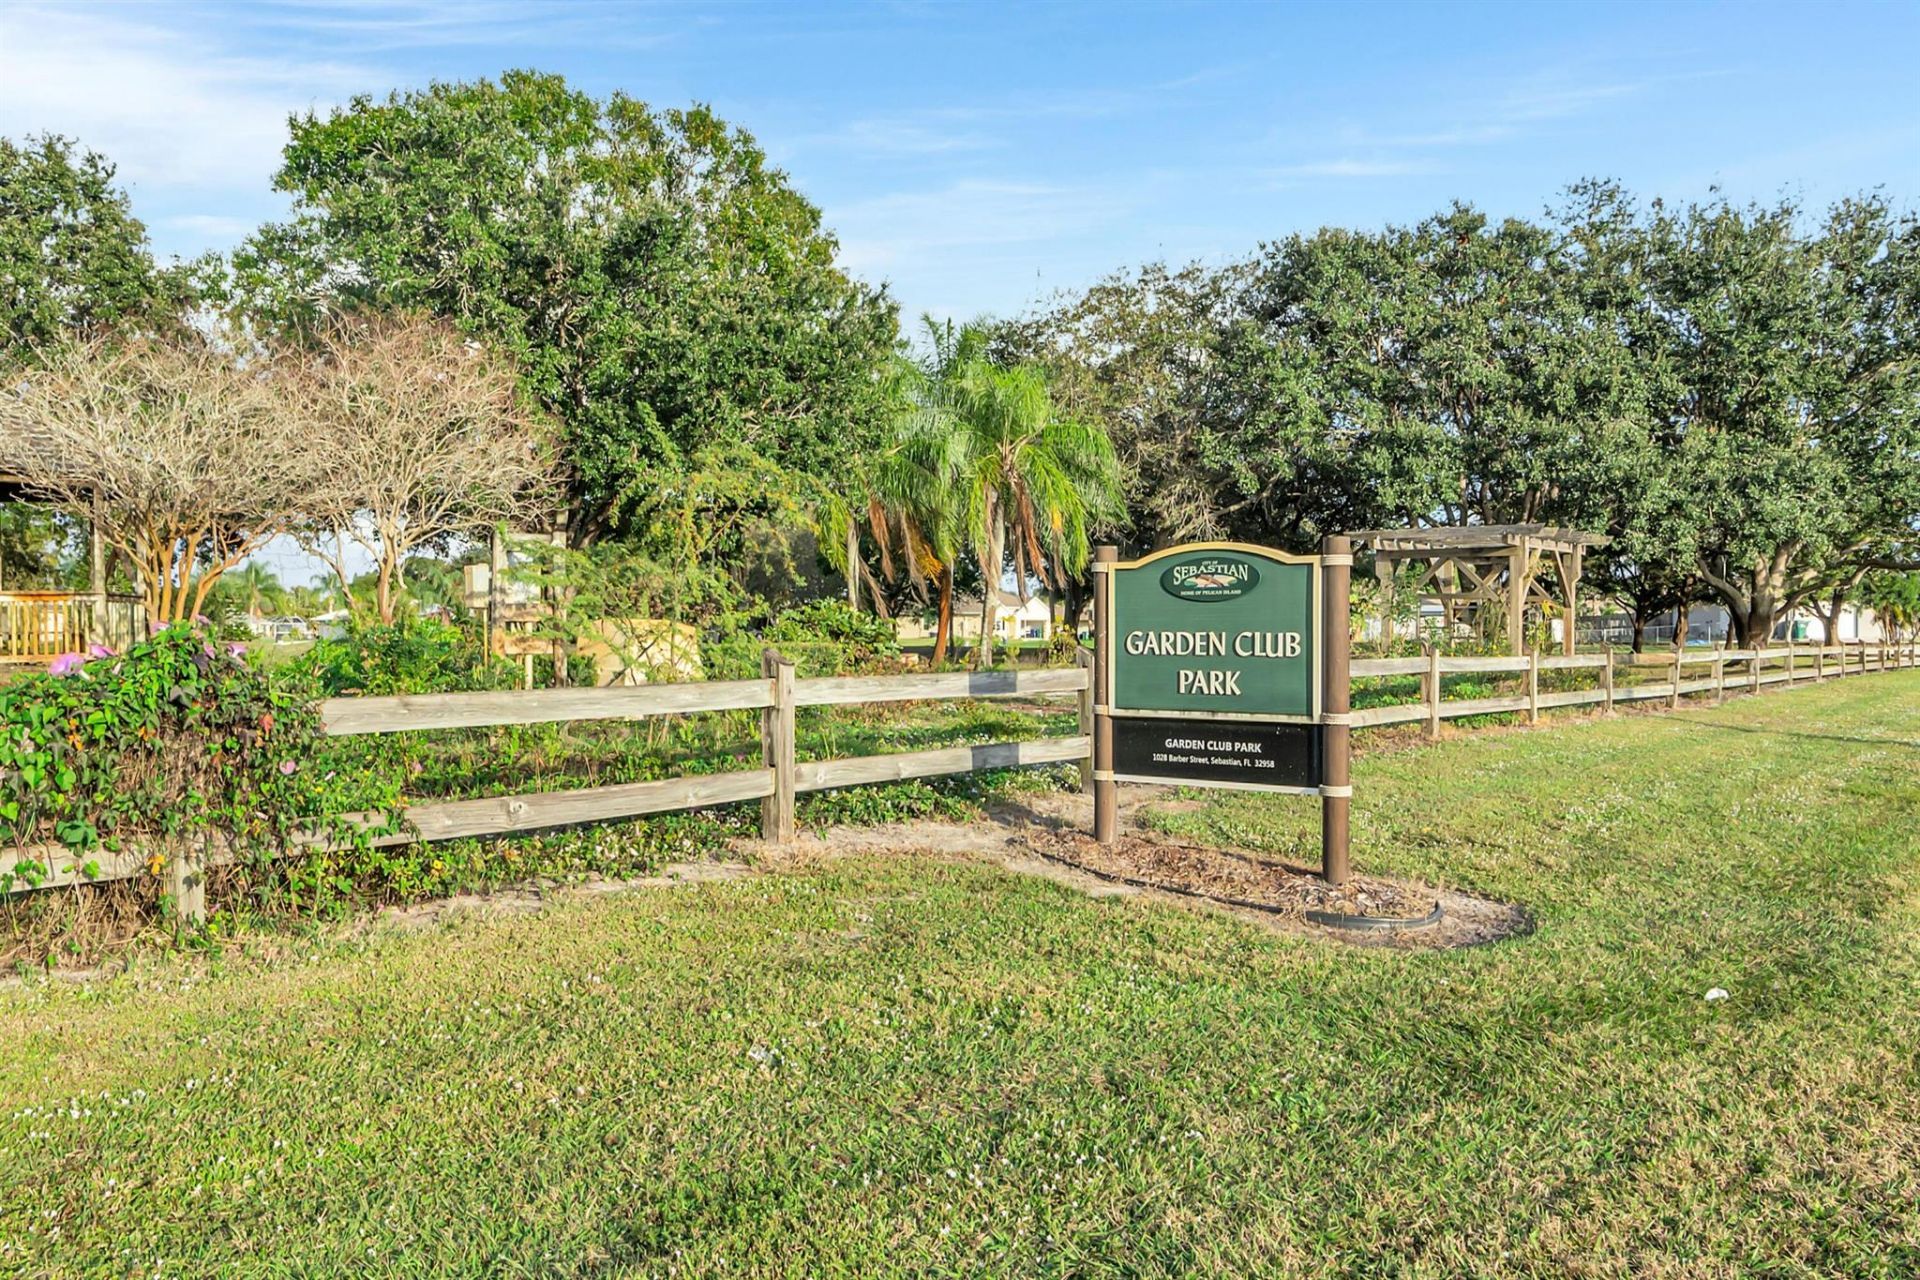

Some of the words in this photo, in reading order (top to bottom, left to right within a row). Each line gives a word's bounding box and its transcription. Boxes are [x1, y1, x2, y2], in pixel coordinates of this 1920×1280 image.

[1173, 564, 1248, 585] SEBASTIAN
[1125, 630, 1226, 656] GARDEN
[1234, 631, 1301, 658] CLUB
[1178, 669, 1241, 695] PARK
[1165, 738, 1205, 750] GARDEN
[1207, 740, 1232, 751] CLUB
[1234, 742, 1262, 753] PARK
[1152, 753, 1168, 762] 1028
[1168, 754, 1188, 763] Barber
[1190, 755, 1210, 764] Street,
[1211, 756, 1242, 766] Sebastian,
[1244, 758, 1252, 767] FL
[1254, 759, 1275, 768] 32958
